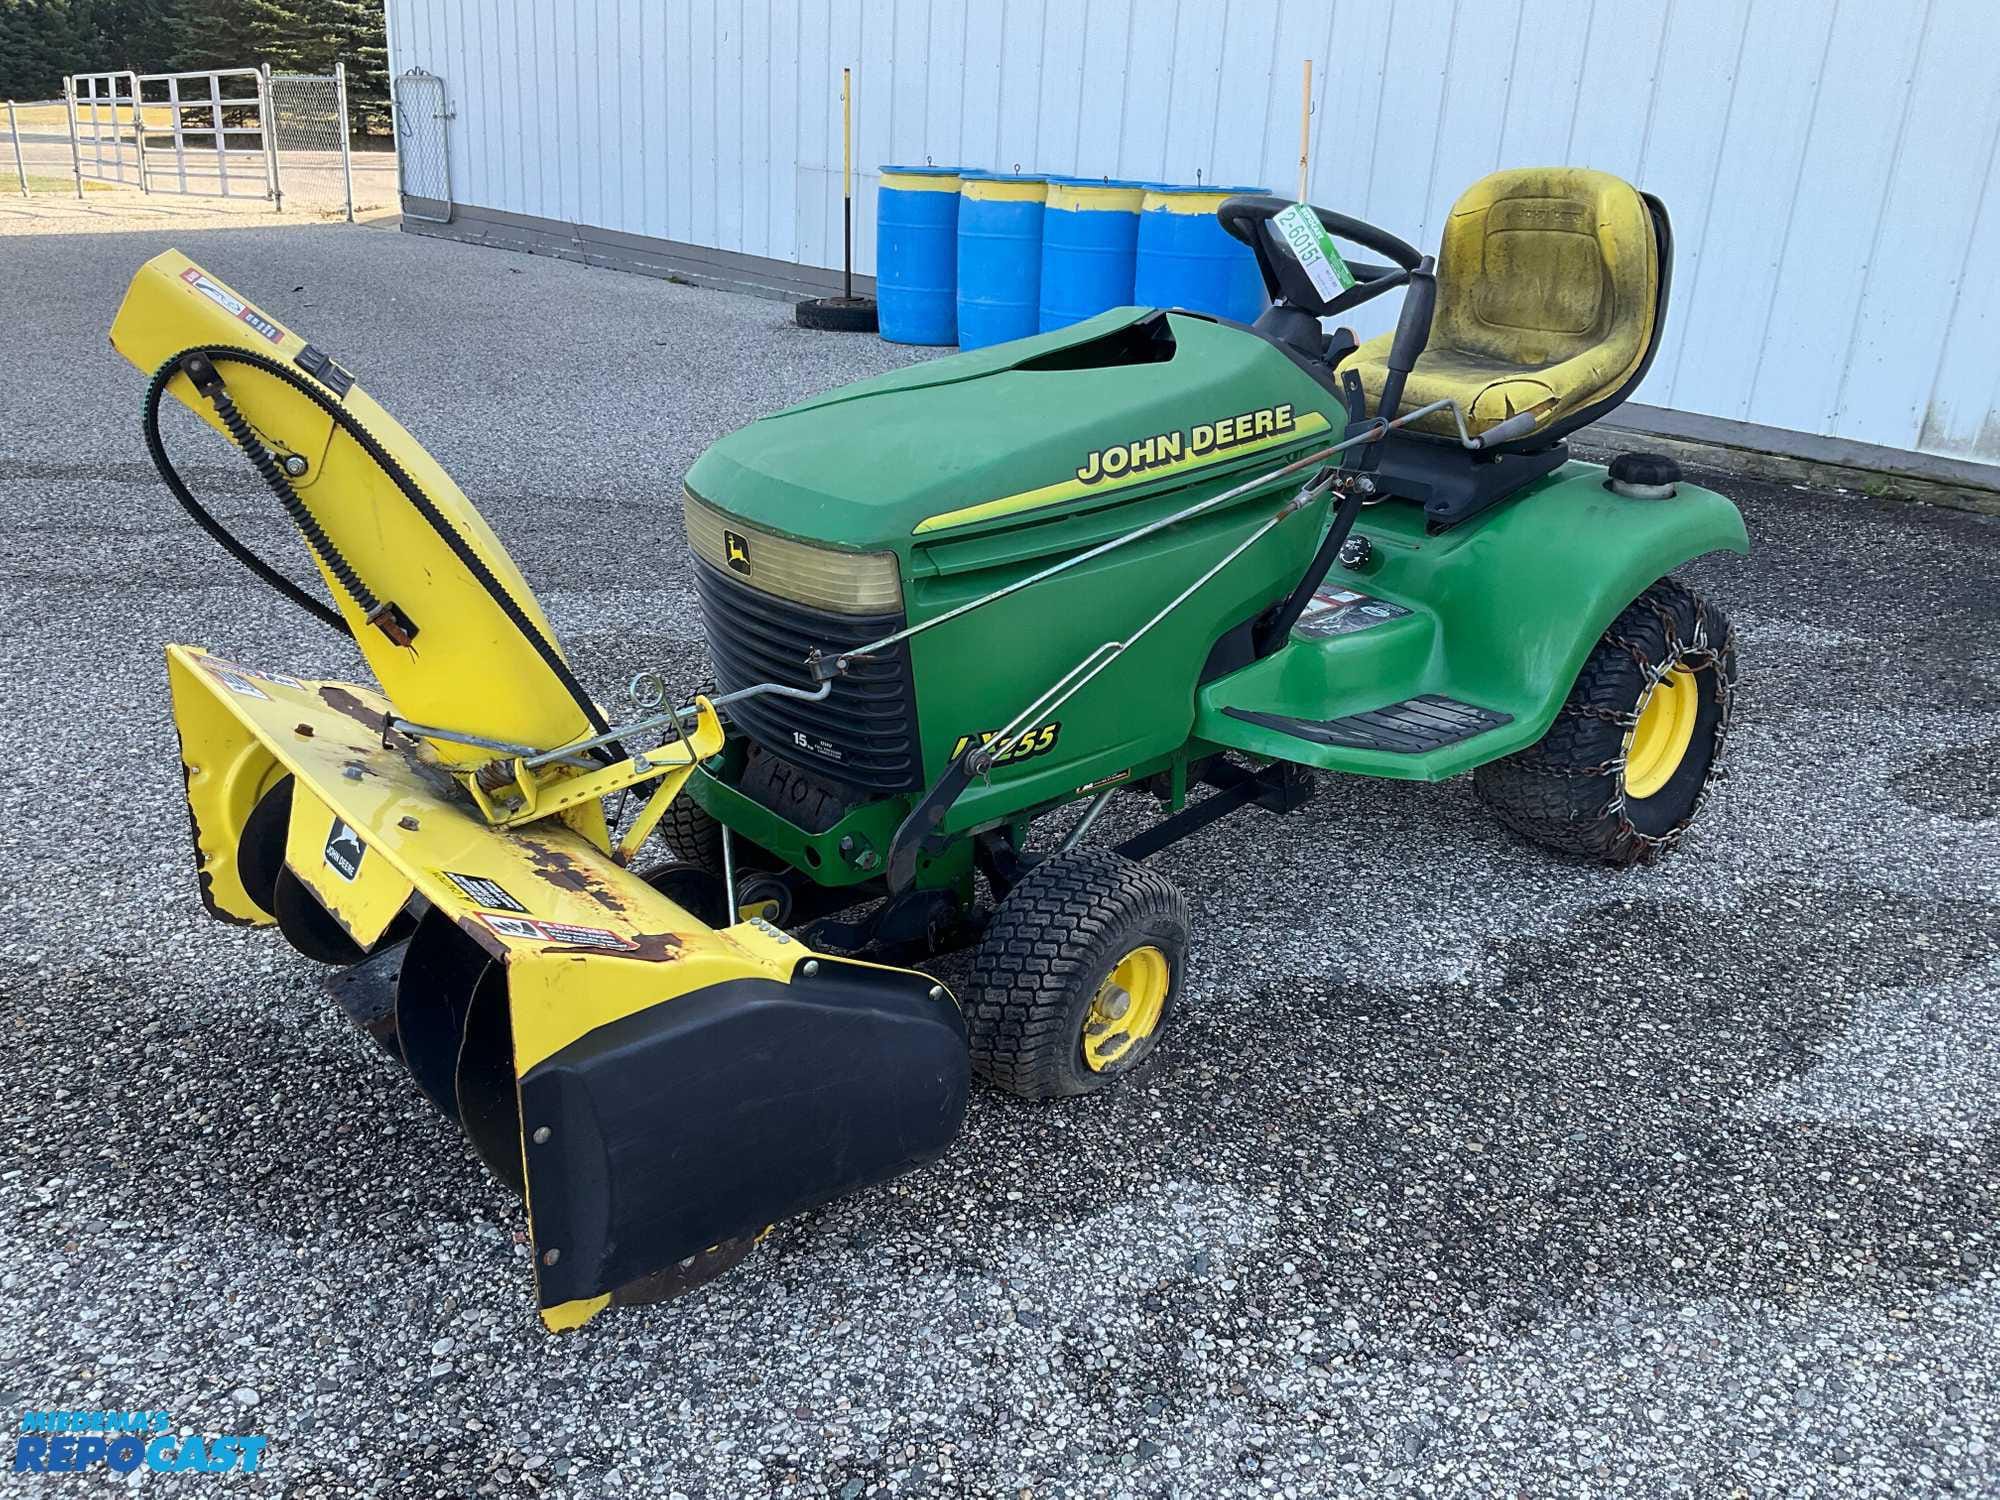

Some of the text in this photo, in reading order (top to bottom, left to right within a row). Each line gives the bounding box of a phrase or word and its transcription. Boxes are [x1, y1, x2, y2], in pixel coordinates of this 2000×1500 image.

[1279, 212, 1322, 267] 2-60151
[1077, 404, 1294, 482] JOHN DEERE
[793, 731, 807, 748] 15
[768, 762, 833, 817] HOT
